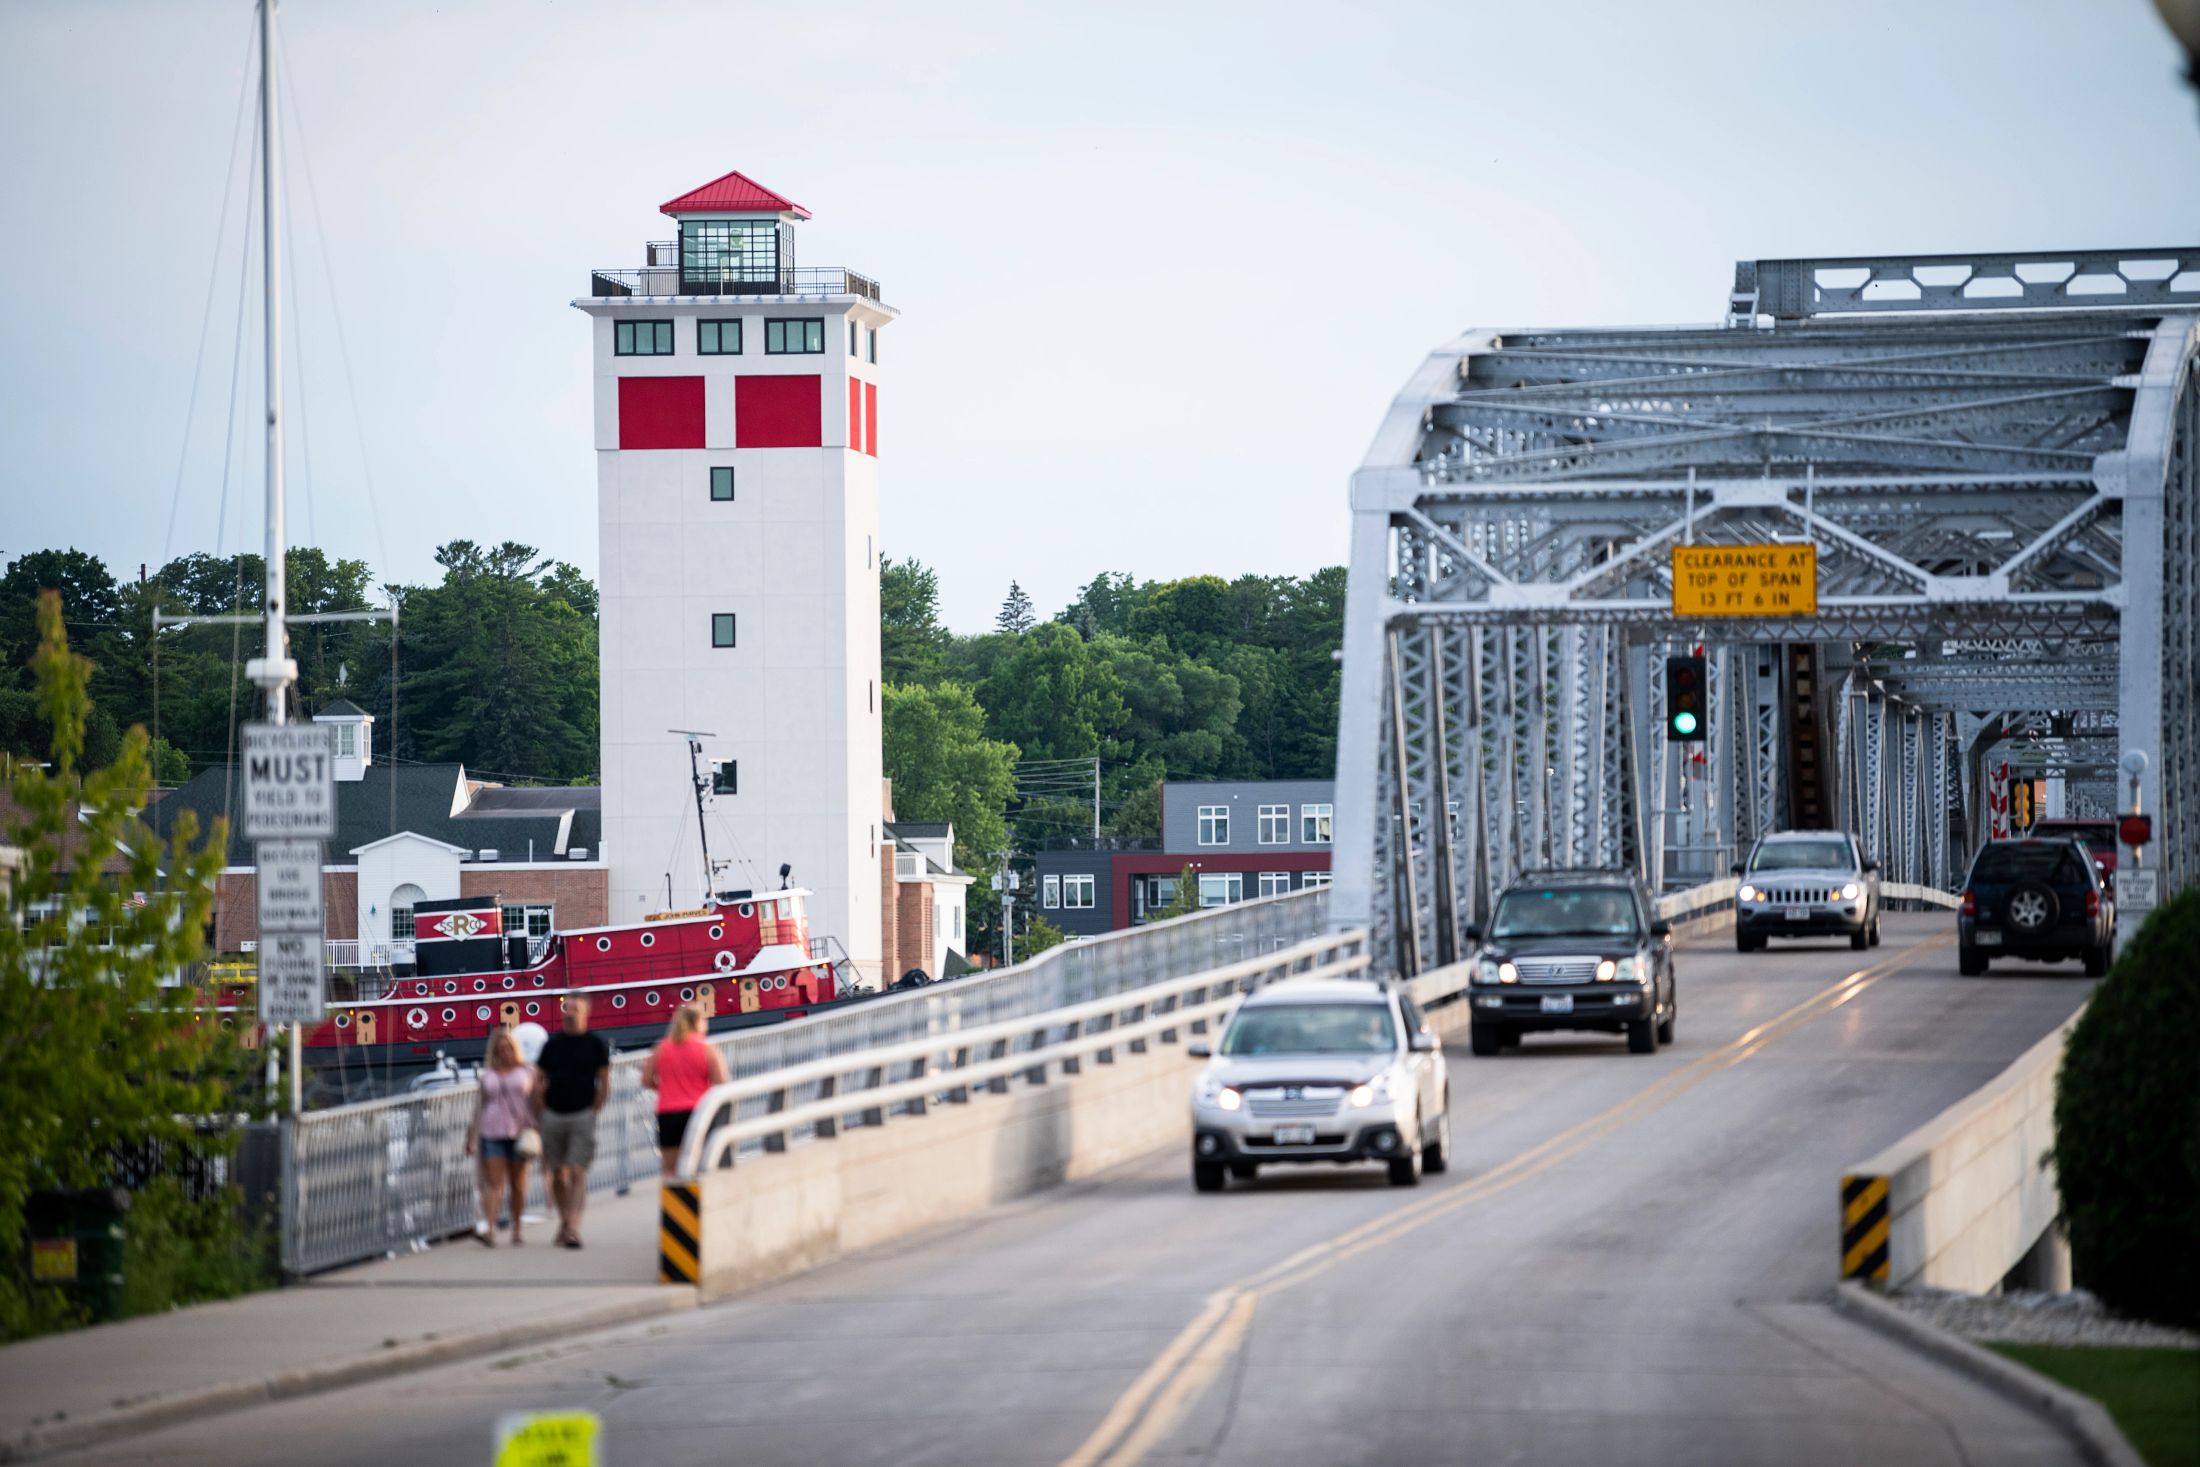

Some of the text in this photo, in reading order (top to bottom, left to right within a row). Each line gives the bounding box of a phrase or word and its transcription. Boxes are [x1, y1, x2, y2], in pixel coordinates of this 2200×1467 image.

[1684, 552, 1807, 568] CLEARANCE AT
[1688, 572, 1802, 588] TOP OF SPAN
[1726, 592, 1744, 606] FT
[1772, 591, 1790, 606] IN
[250, 754, 324, 785] MUST
